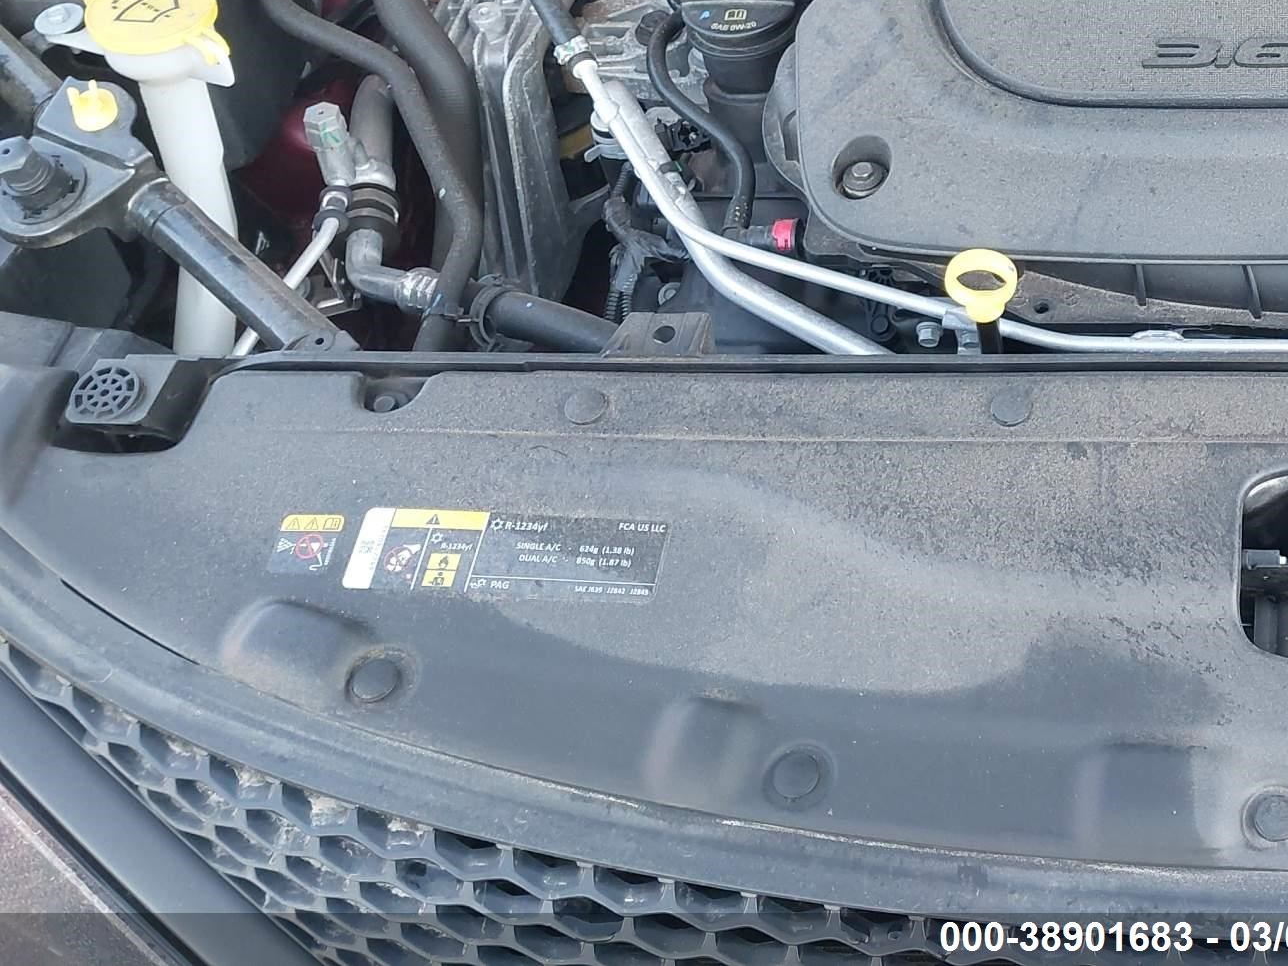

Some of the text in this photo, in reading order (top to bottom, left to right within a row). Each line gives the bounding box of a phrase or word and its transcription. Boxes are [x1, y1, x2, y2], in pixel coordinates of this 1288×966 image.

[505, 521, 666, 533] R-1234yf FCA US LLC
[516, 541, 546, 551] SINGLE
[547, 543, 562, 552] A/C
[519, 554, 541, 563] DUAL
[542, 555, 558, 564] A/C
[490, 579, 510, 590] PAG
